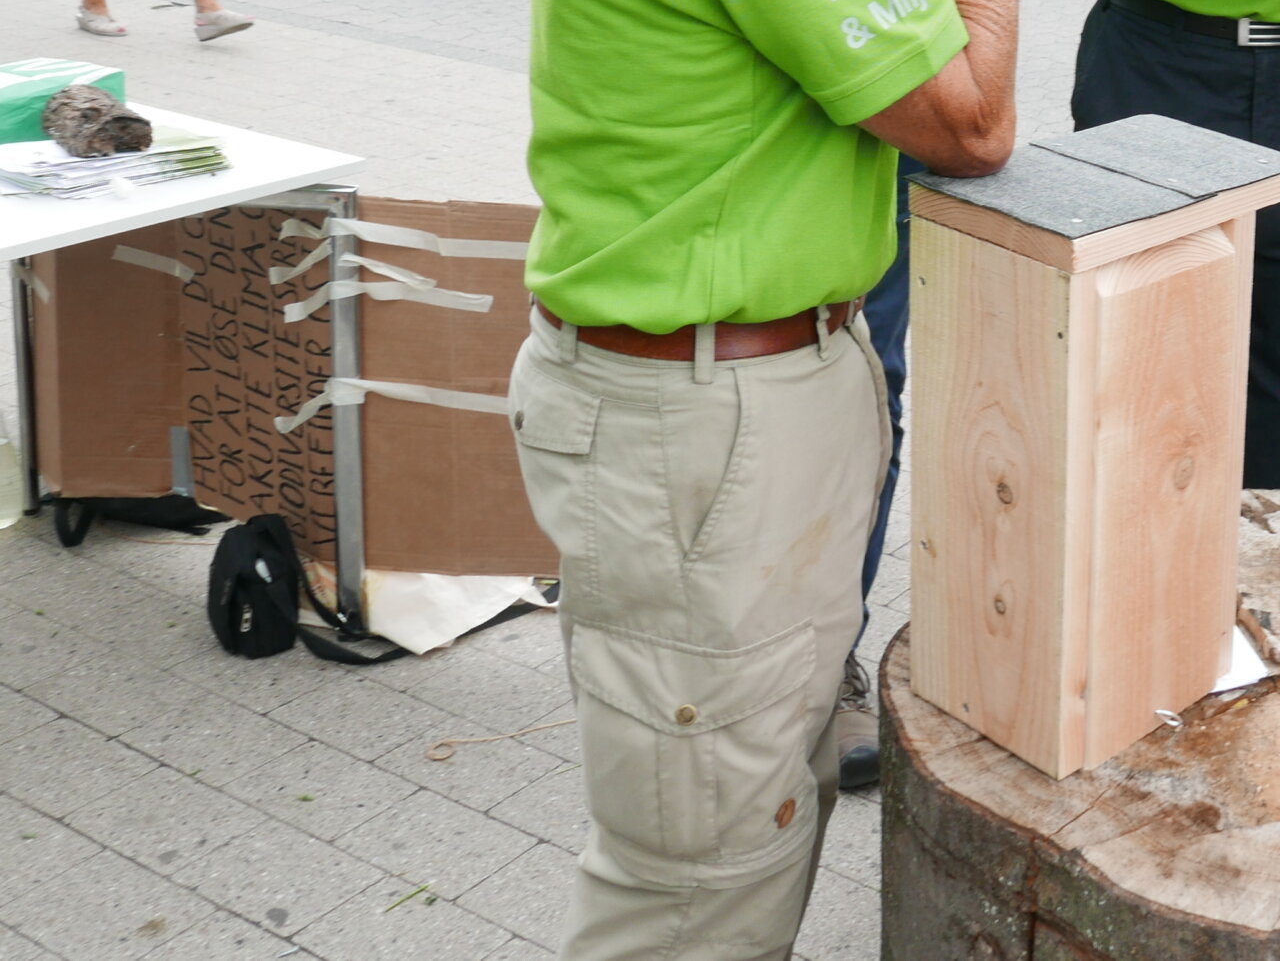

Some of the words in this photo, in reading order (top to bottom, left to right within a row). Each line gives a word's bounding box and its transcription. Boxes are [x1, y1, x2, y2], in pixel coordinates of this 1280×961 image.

[840, 16, 878, 50] &
[182, 249, 208, 303] DU
[185, 320, 212, 372] VIL
[209, 289, 242, 381] LØSE
[214, 383, 243, 438] AT
[189, 394, 217, 493] HVAD
[244, 371, 275, 515] AKUTTE
[218, 443, 247, 506] FOR
